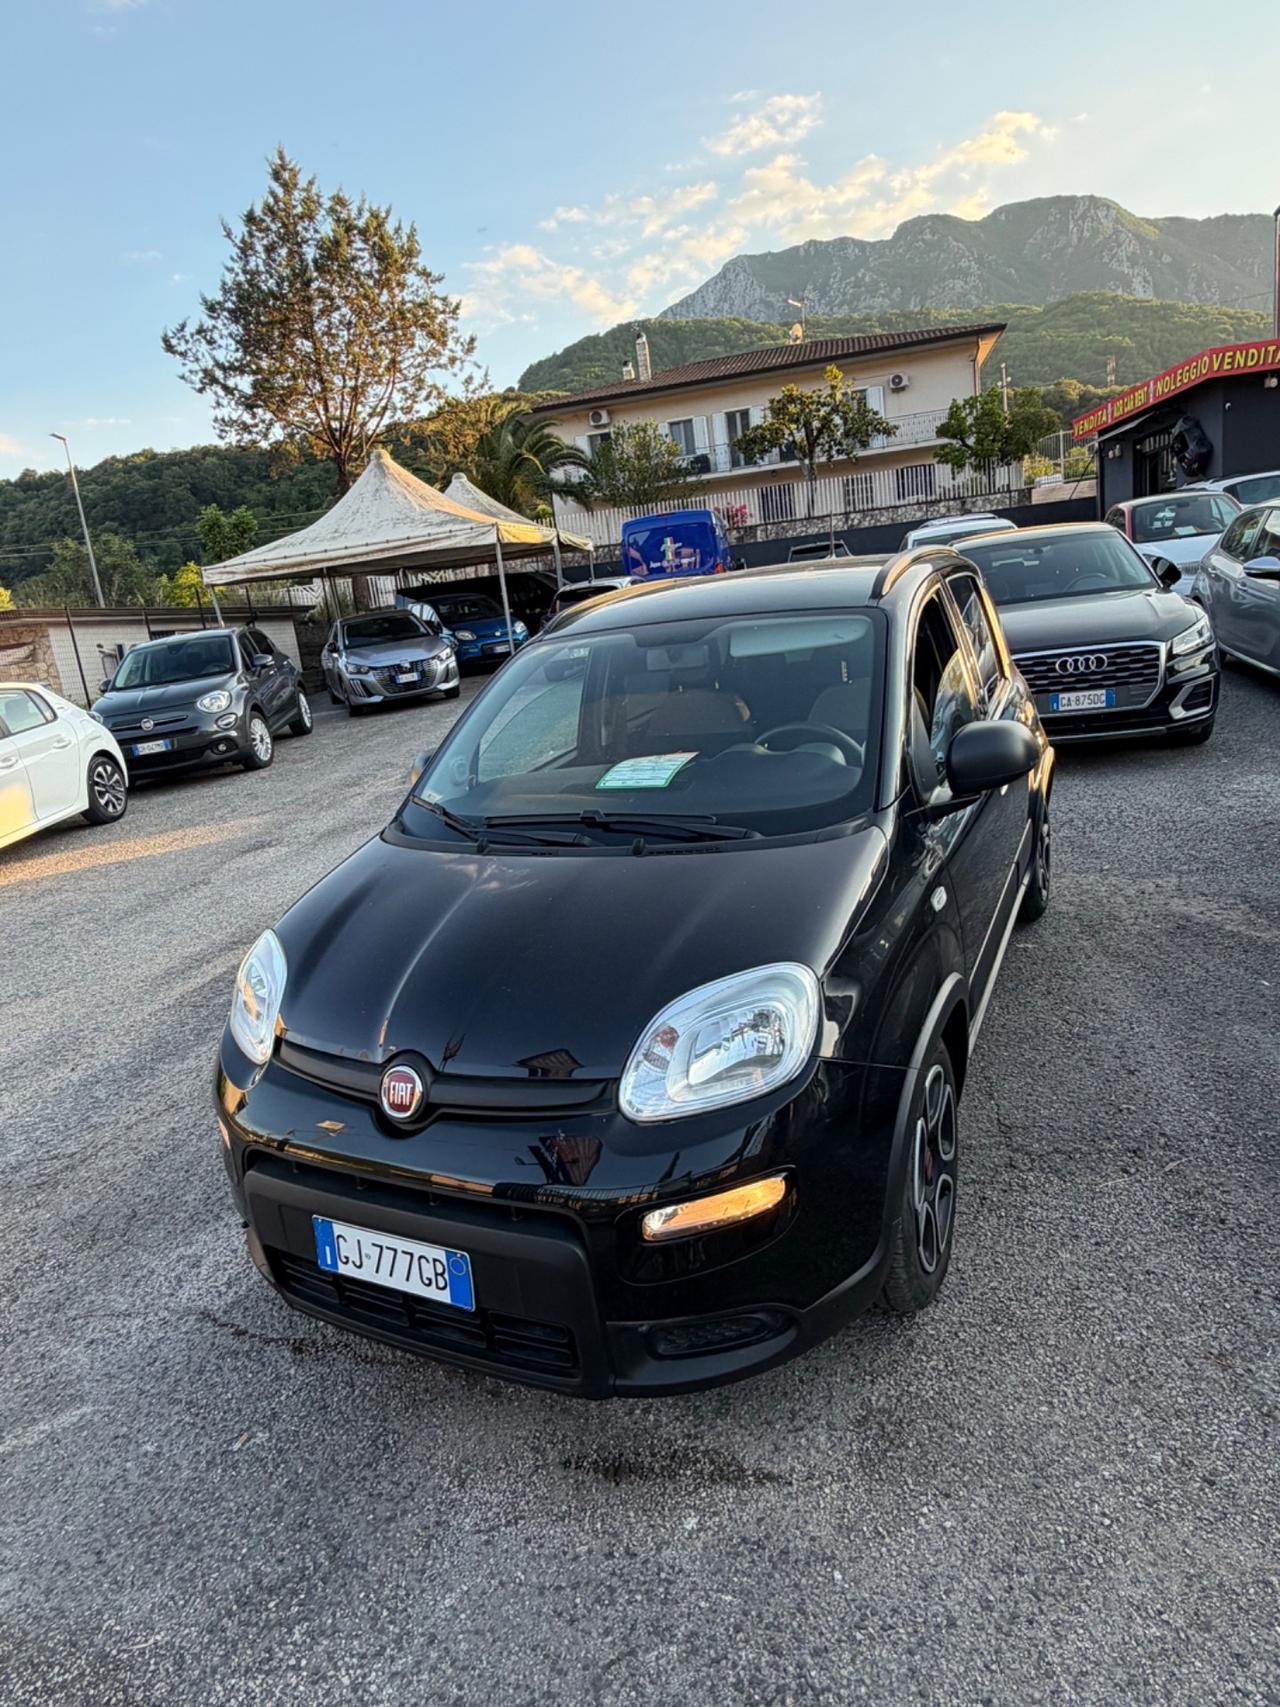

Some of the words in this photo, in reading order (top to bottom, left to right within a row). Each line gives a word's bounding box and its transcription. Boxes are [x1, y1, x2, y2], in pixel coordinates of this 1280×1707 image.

[1073, 408, 1108, 437] VENDITA
[1155, 355, 1210, 397] NOLEGGIO
[389, 1081, 414, 1106] FIAT
